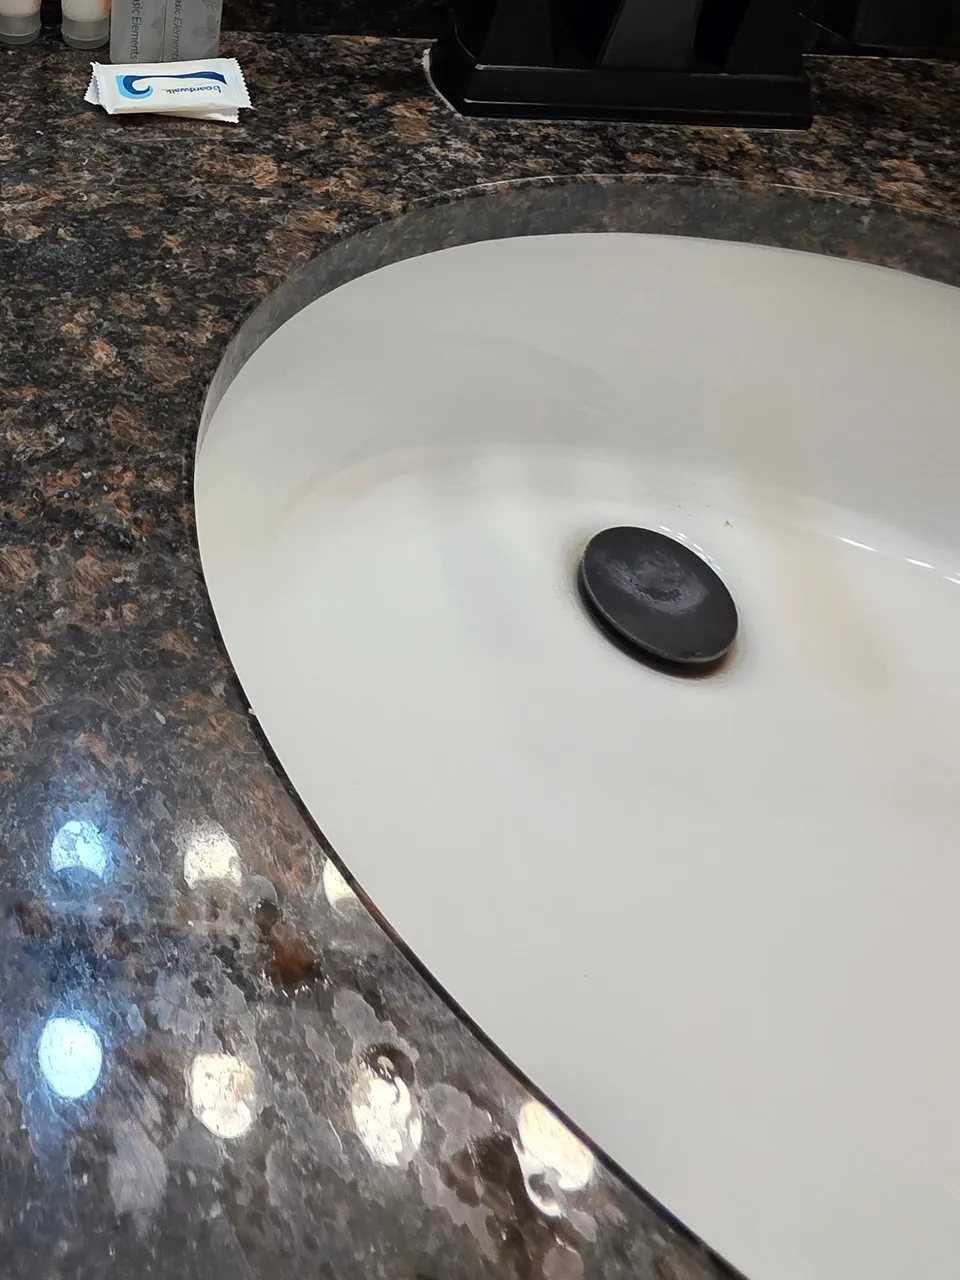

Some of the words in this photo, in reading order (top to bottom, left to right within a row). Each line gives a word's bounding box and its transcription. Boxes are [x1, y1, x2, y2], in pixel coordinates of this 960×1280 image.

[130, 16, 142, 60] Elements
[172, 17, 183, 61] Elements
[166, 85, 222, 94] boardwalk
